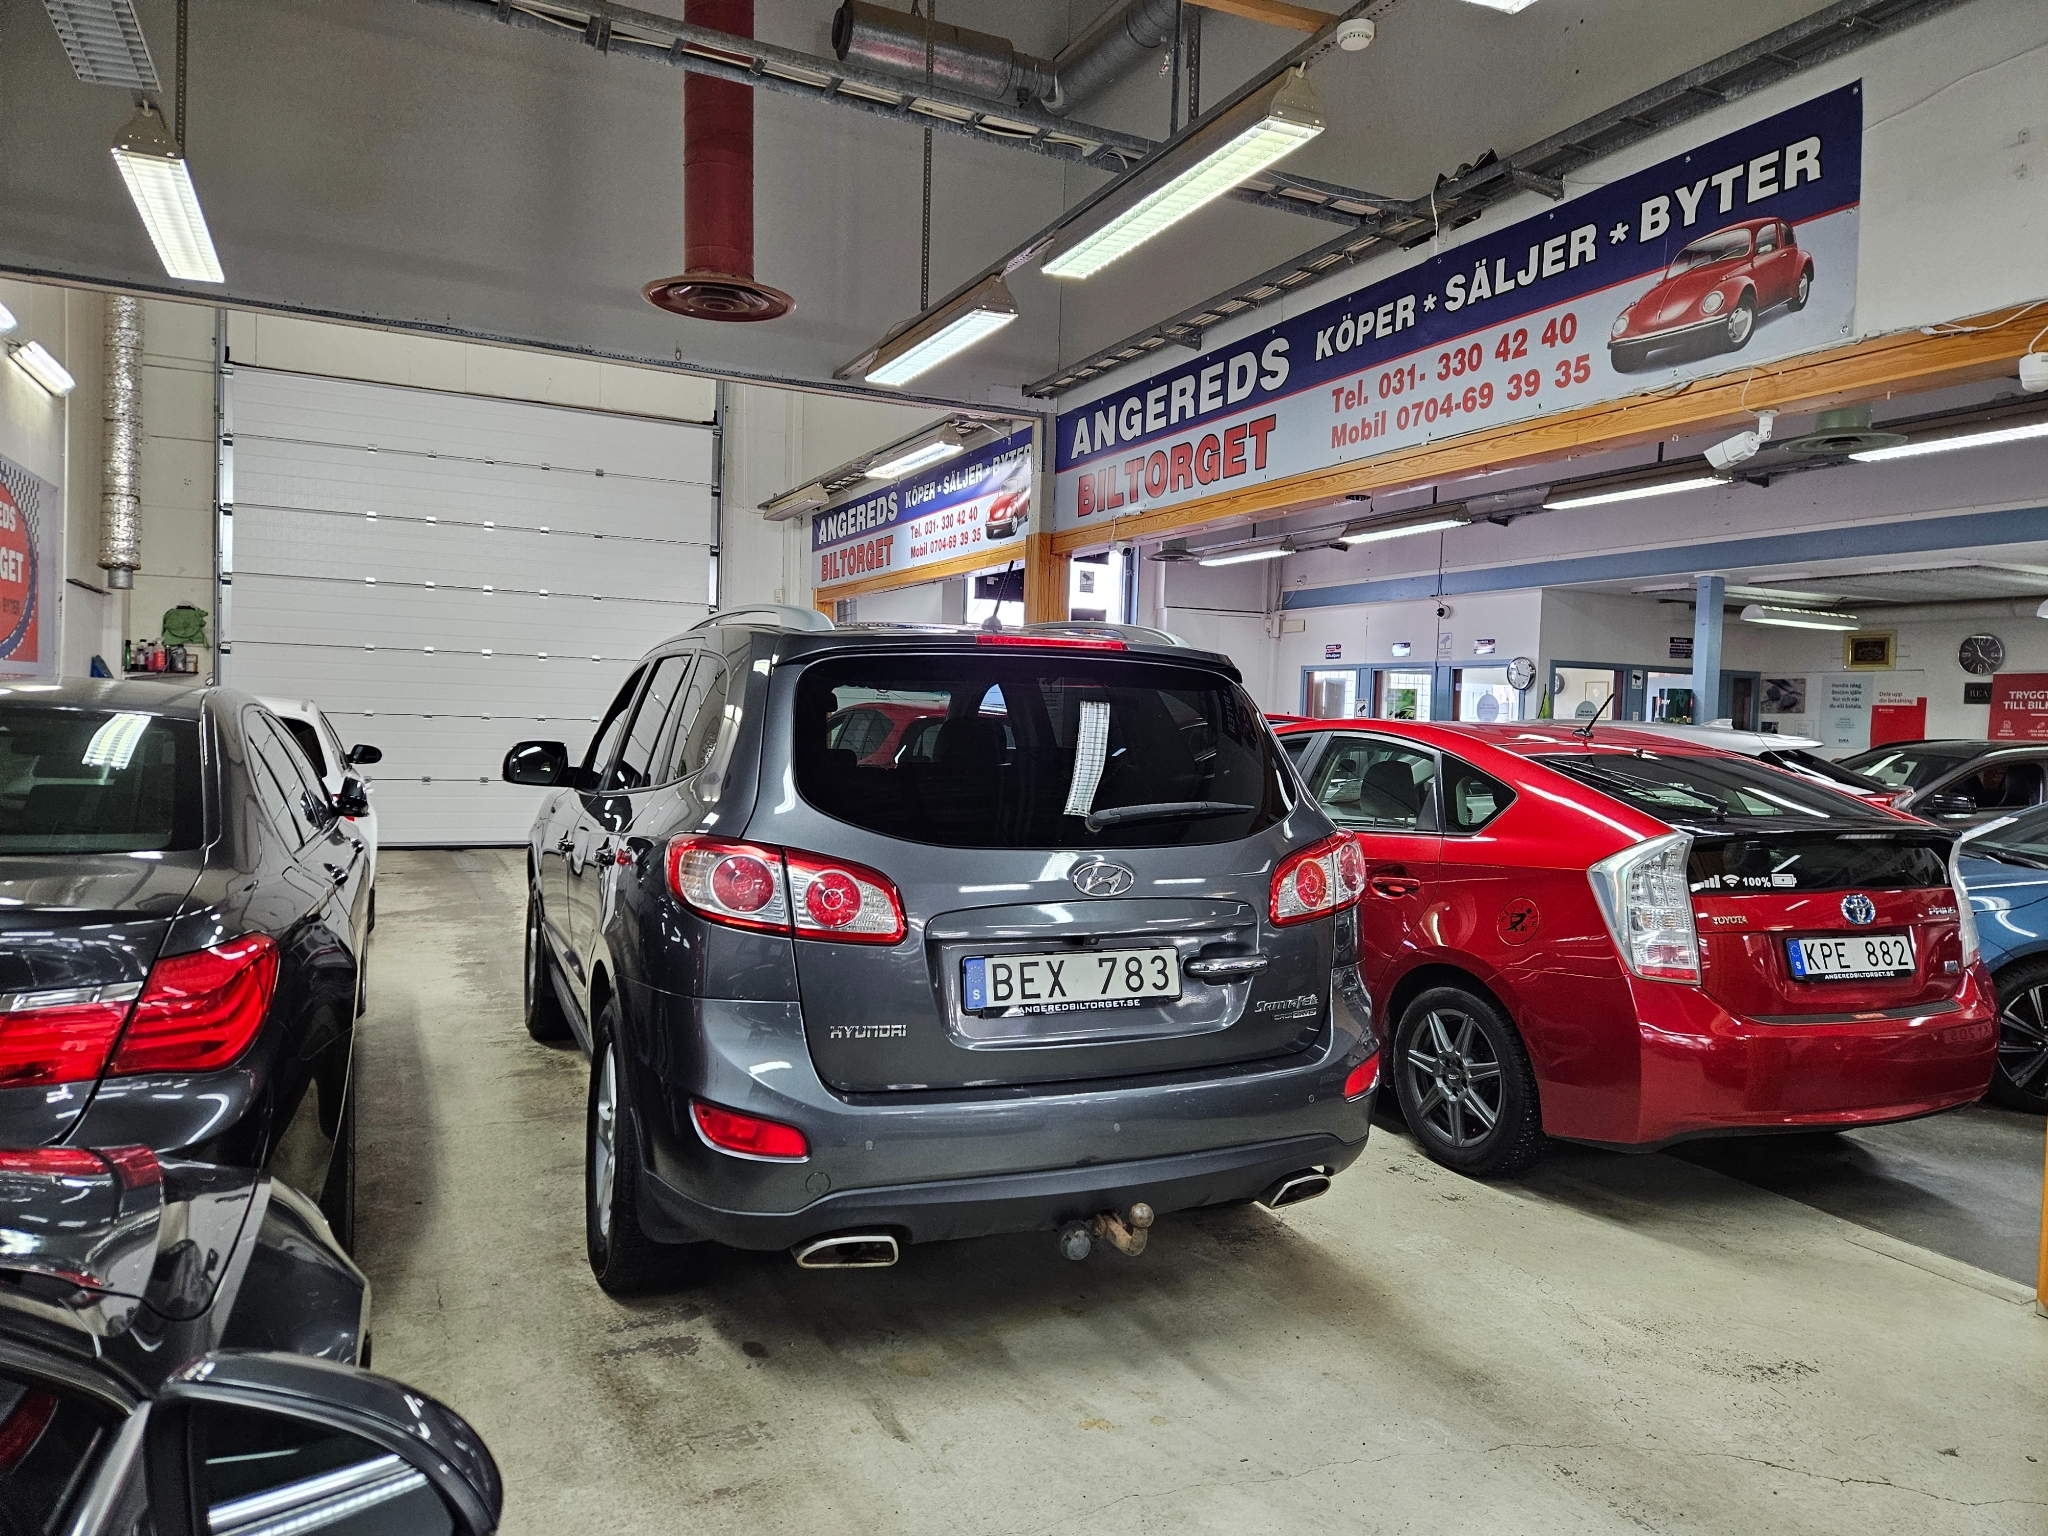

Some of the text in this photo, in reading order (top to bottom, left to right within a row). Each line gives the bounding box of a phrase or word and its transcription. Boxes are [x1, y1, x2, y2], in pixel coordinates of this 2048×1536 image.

[1315, 136, 1822, 361] KÖPER SÄLJER BYTER
[1332, 312, 1577, 413] Tel. 031- 330 42 40
[1070, 337, 1290, 460] ANGEREDS
[1331, 354, 1591, 449] Mobil 0704-69 39 35
[905, 483, 936, 508] KÖPER
[943, 462, 983, 496] SÄLJER
[1077, 414, 1276, 517] BILTORGET
[818, 491, 898, 545] ANGEREDS
[910, 525, 923, 540] Tel.
[941, 516, 954, 531] 330
[956, 511, 966, 525] 42
[968, 505, 978, 522] 40
[821, 535, 894, 582] BILTORGET
[910, 527, 982, 559] Mobil 0704-69 39 35
[2003, 701, 2025, 710] TILL
[1743, 877, 1771, 888] 100%
[1713, 916, 1748, 925] TOYOTA
[1804, 940, 1909, 970] KPE 882
[973, 989, 980, 1000] S
[992, 955, 1170, 1002] BEX 783
[1019, 999, 1141, 1014] ANGEREDBILTORGET.SE
[830, 1024, 907, 1039] HYUNDAI
